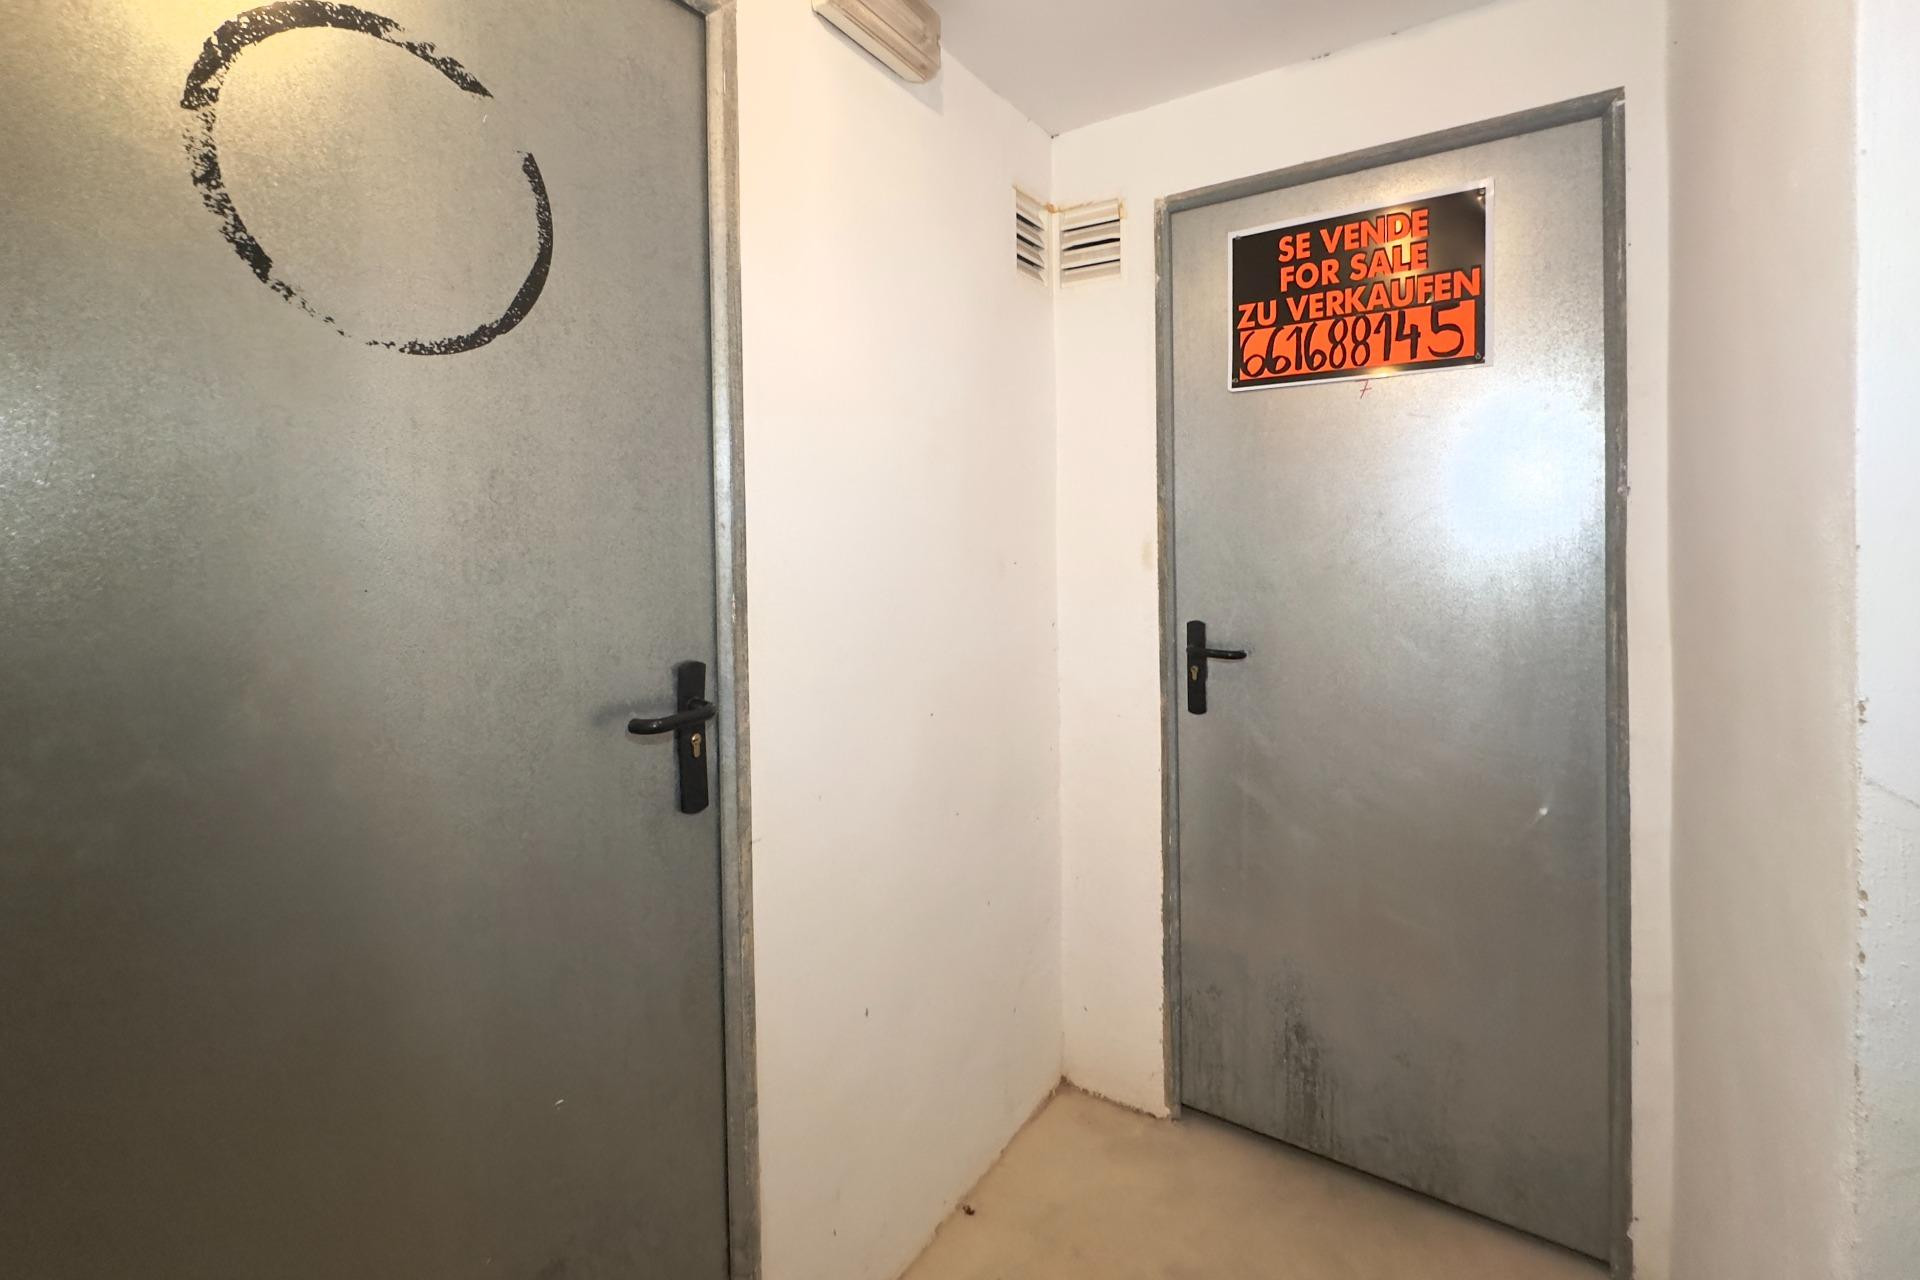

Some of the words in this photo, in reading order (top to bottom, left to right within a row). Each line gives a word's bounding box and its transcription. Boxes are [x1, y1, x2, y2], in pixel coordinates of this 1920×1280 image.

[1278, 231, 1311, 262] SE
[1320, 208, 1429, 254] VENDE
[1280, 258, 1340, 293] FOR
[1350, 241, 1428, 281] SALE
[1237, 298, 1277, 329] ZU
[1287, 267, 1481, 321] VERKAUFEN
[1240, 301, 1465, 378] 661688145
